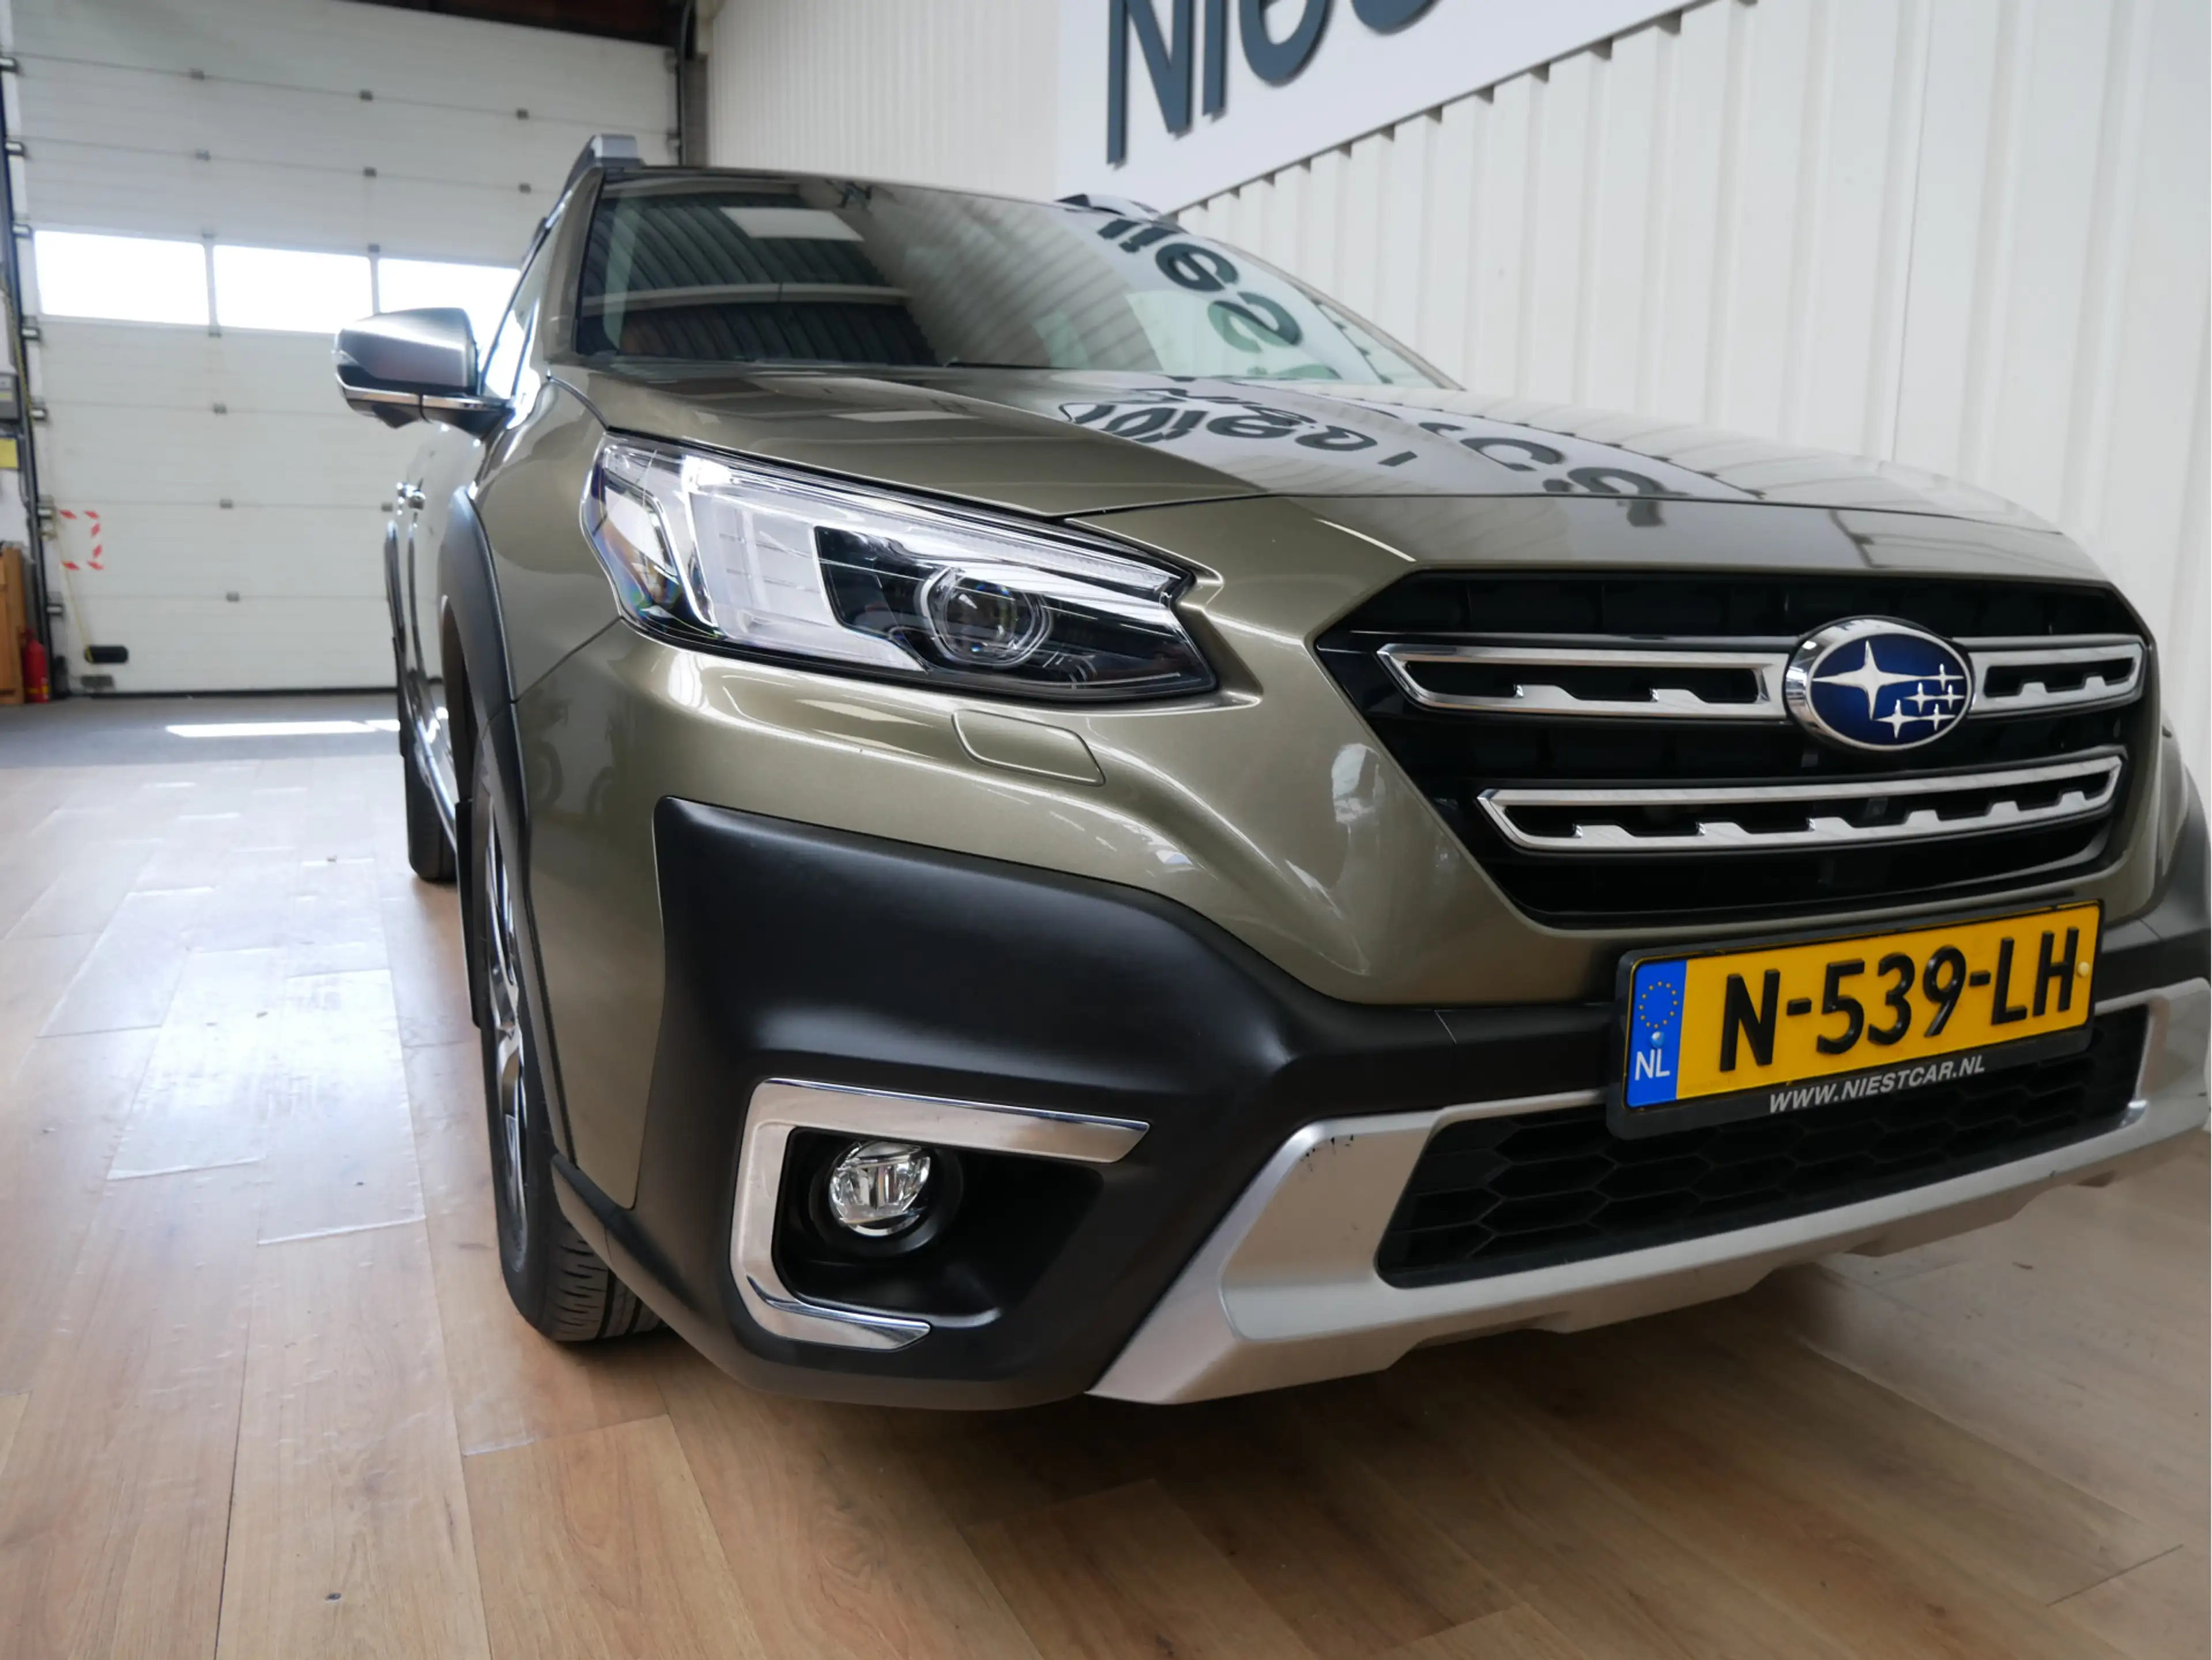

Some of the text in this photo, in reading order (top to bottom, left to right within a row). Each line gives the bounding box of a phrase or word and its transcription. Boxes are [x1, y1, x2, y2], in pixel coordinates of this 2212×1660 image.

[1719, 927, 2080, 1072] N-539-LH
[1634, 1048, 1671, 1081] NL
[1769, 1055, 1985, 1114] WWW.NIESTCAR.NL
